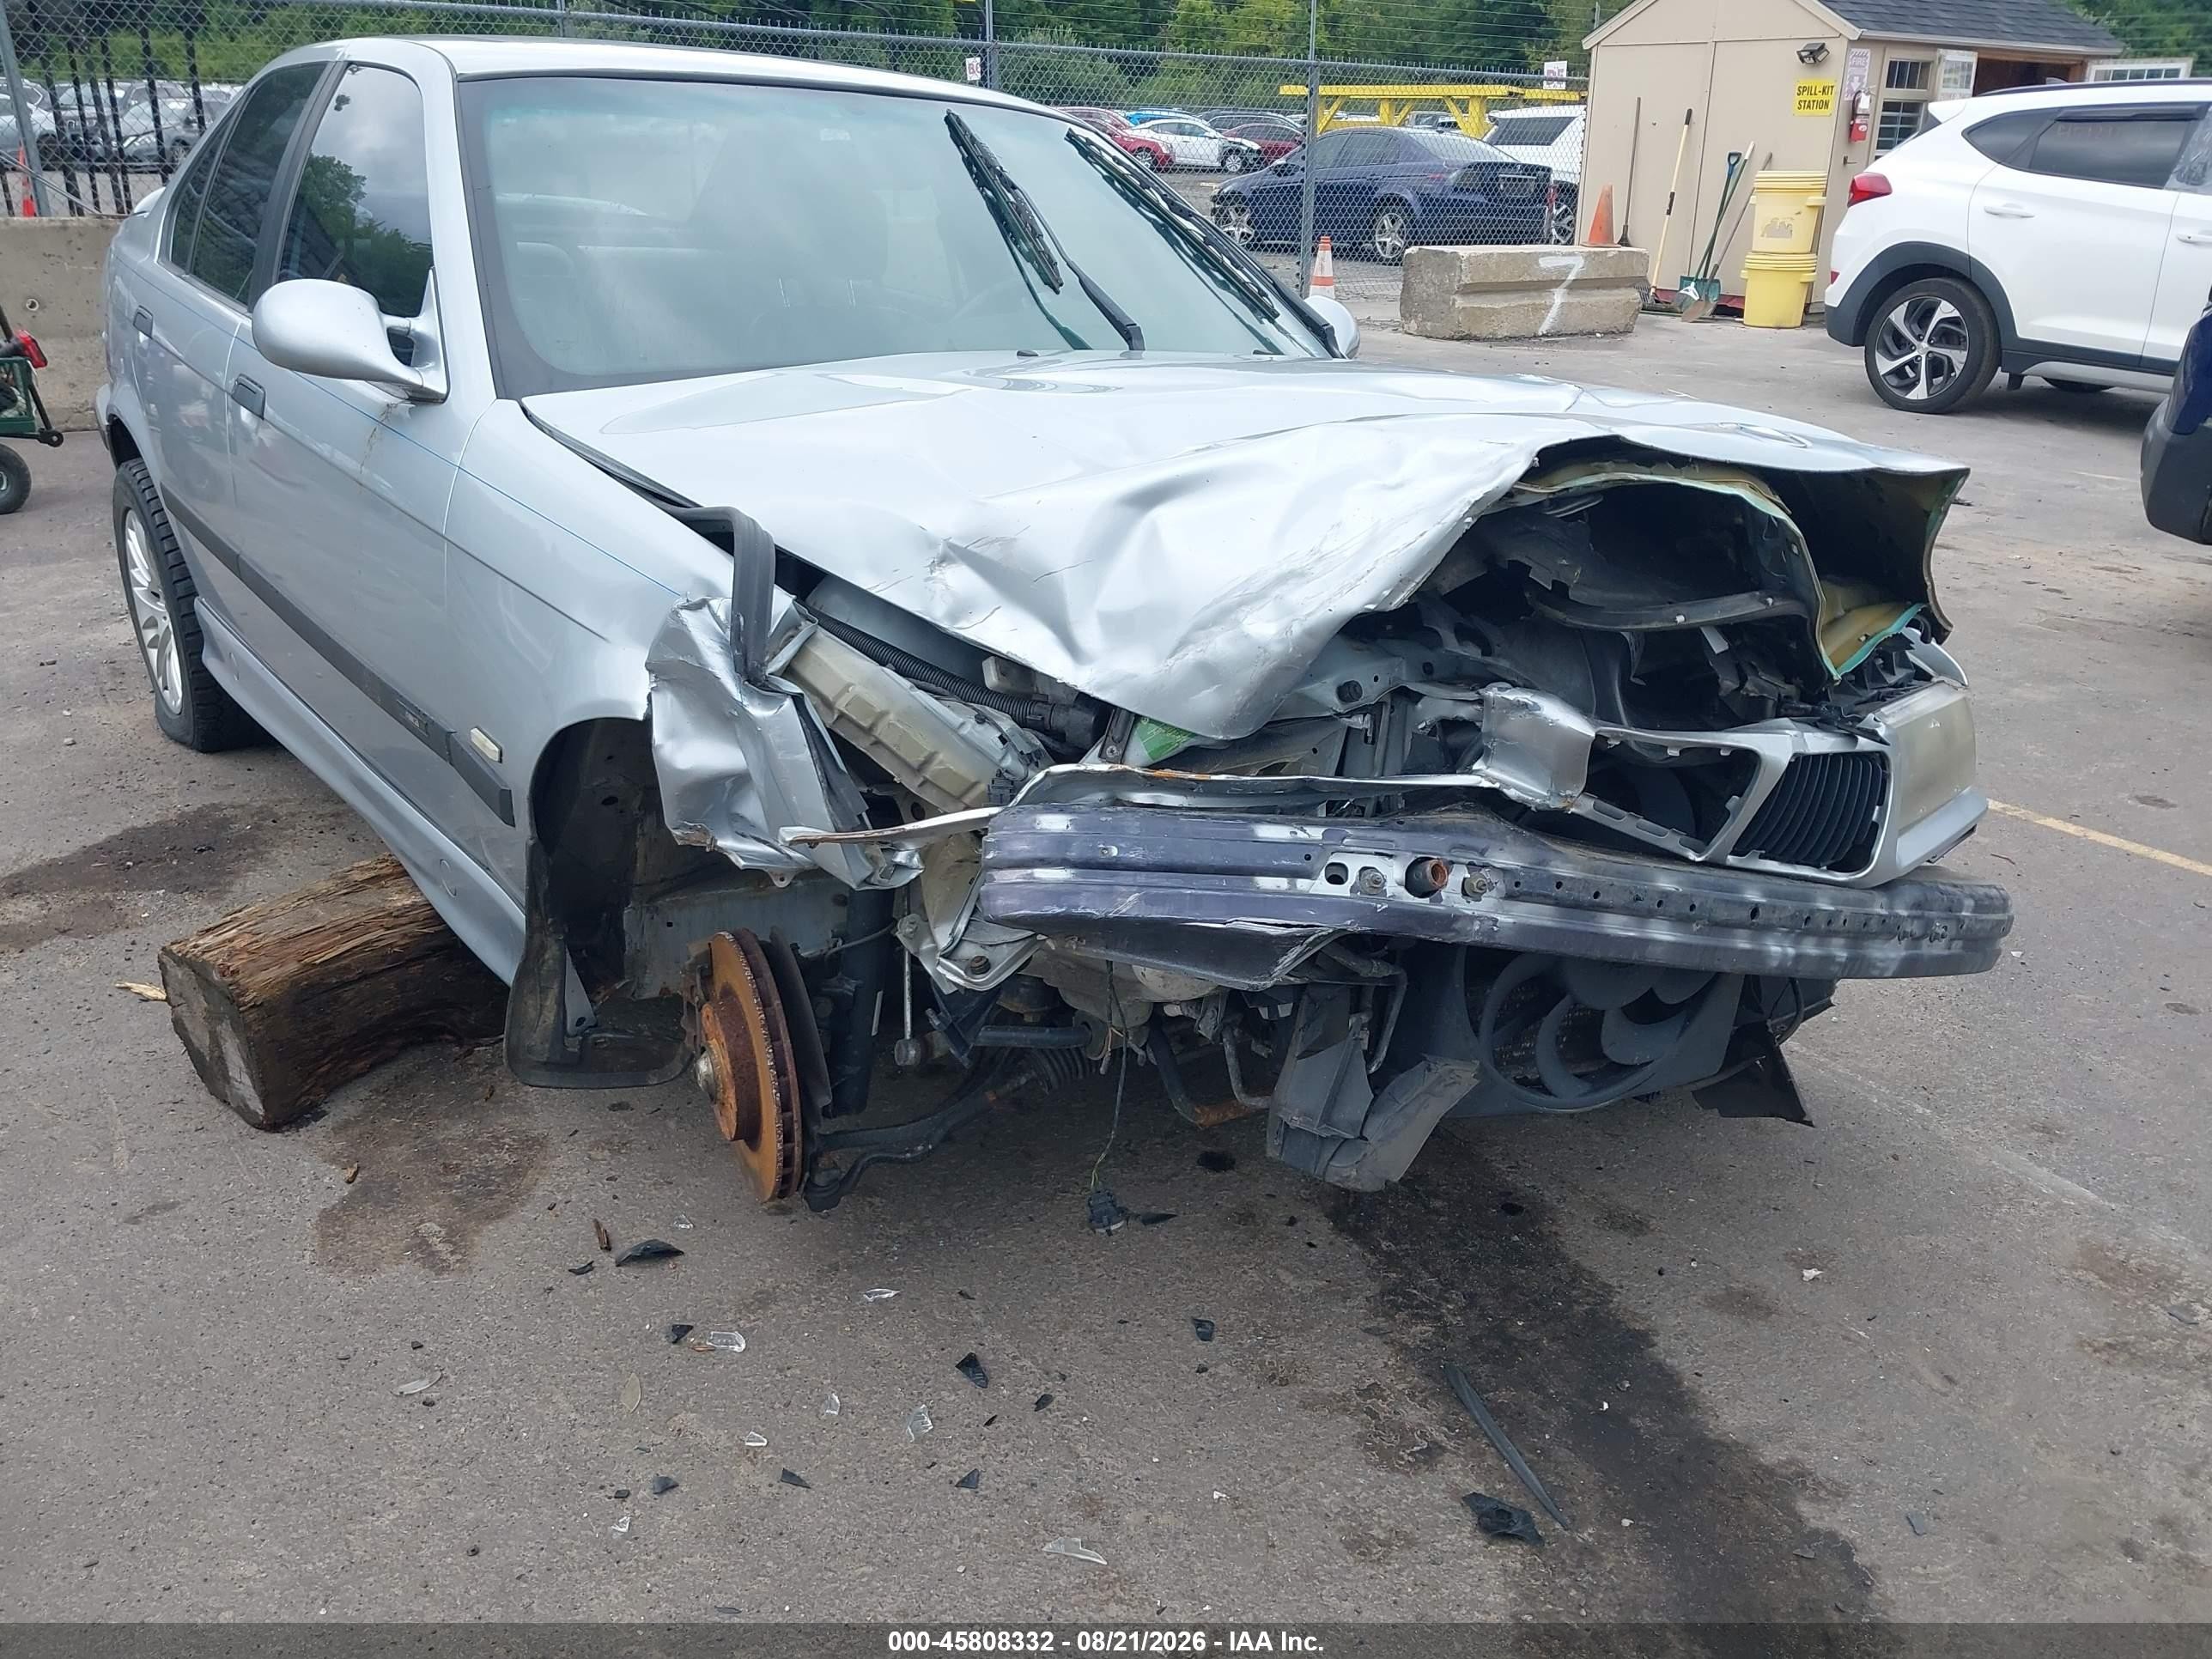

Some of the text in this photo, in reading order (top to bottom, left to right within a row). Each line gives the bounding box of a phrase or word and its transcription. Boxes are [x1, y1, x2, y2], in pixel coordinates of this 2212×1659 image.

[1852, 57, 1867, 66] FIRE
[1796, 85, 1835, 96] SPILL-KIT
[1797, 100, 1830, 110] STATION
